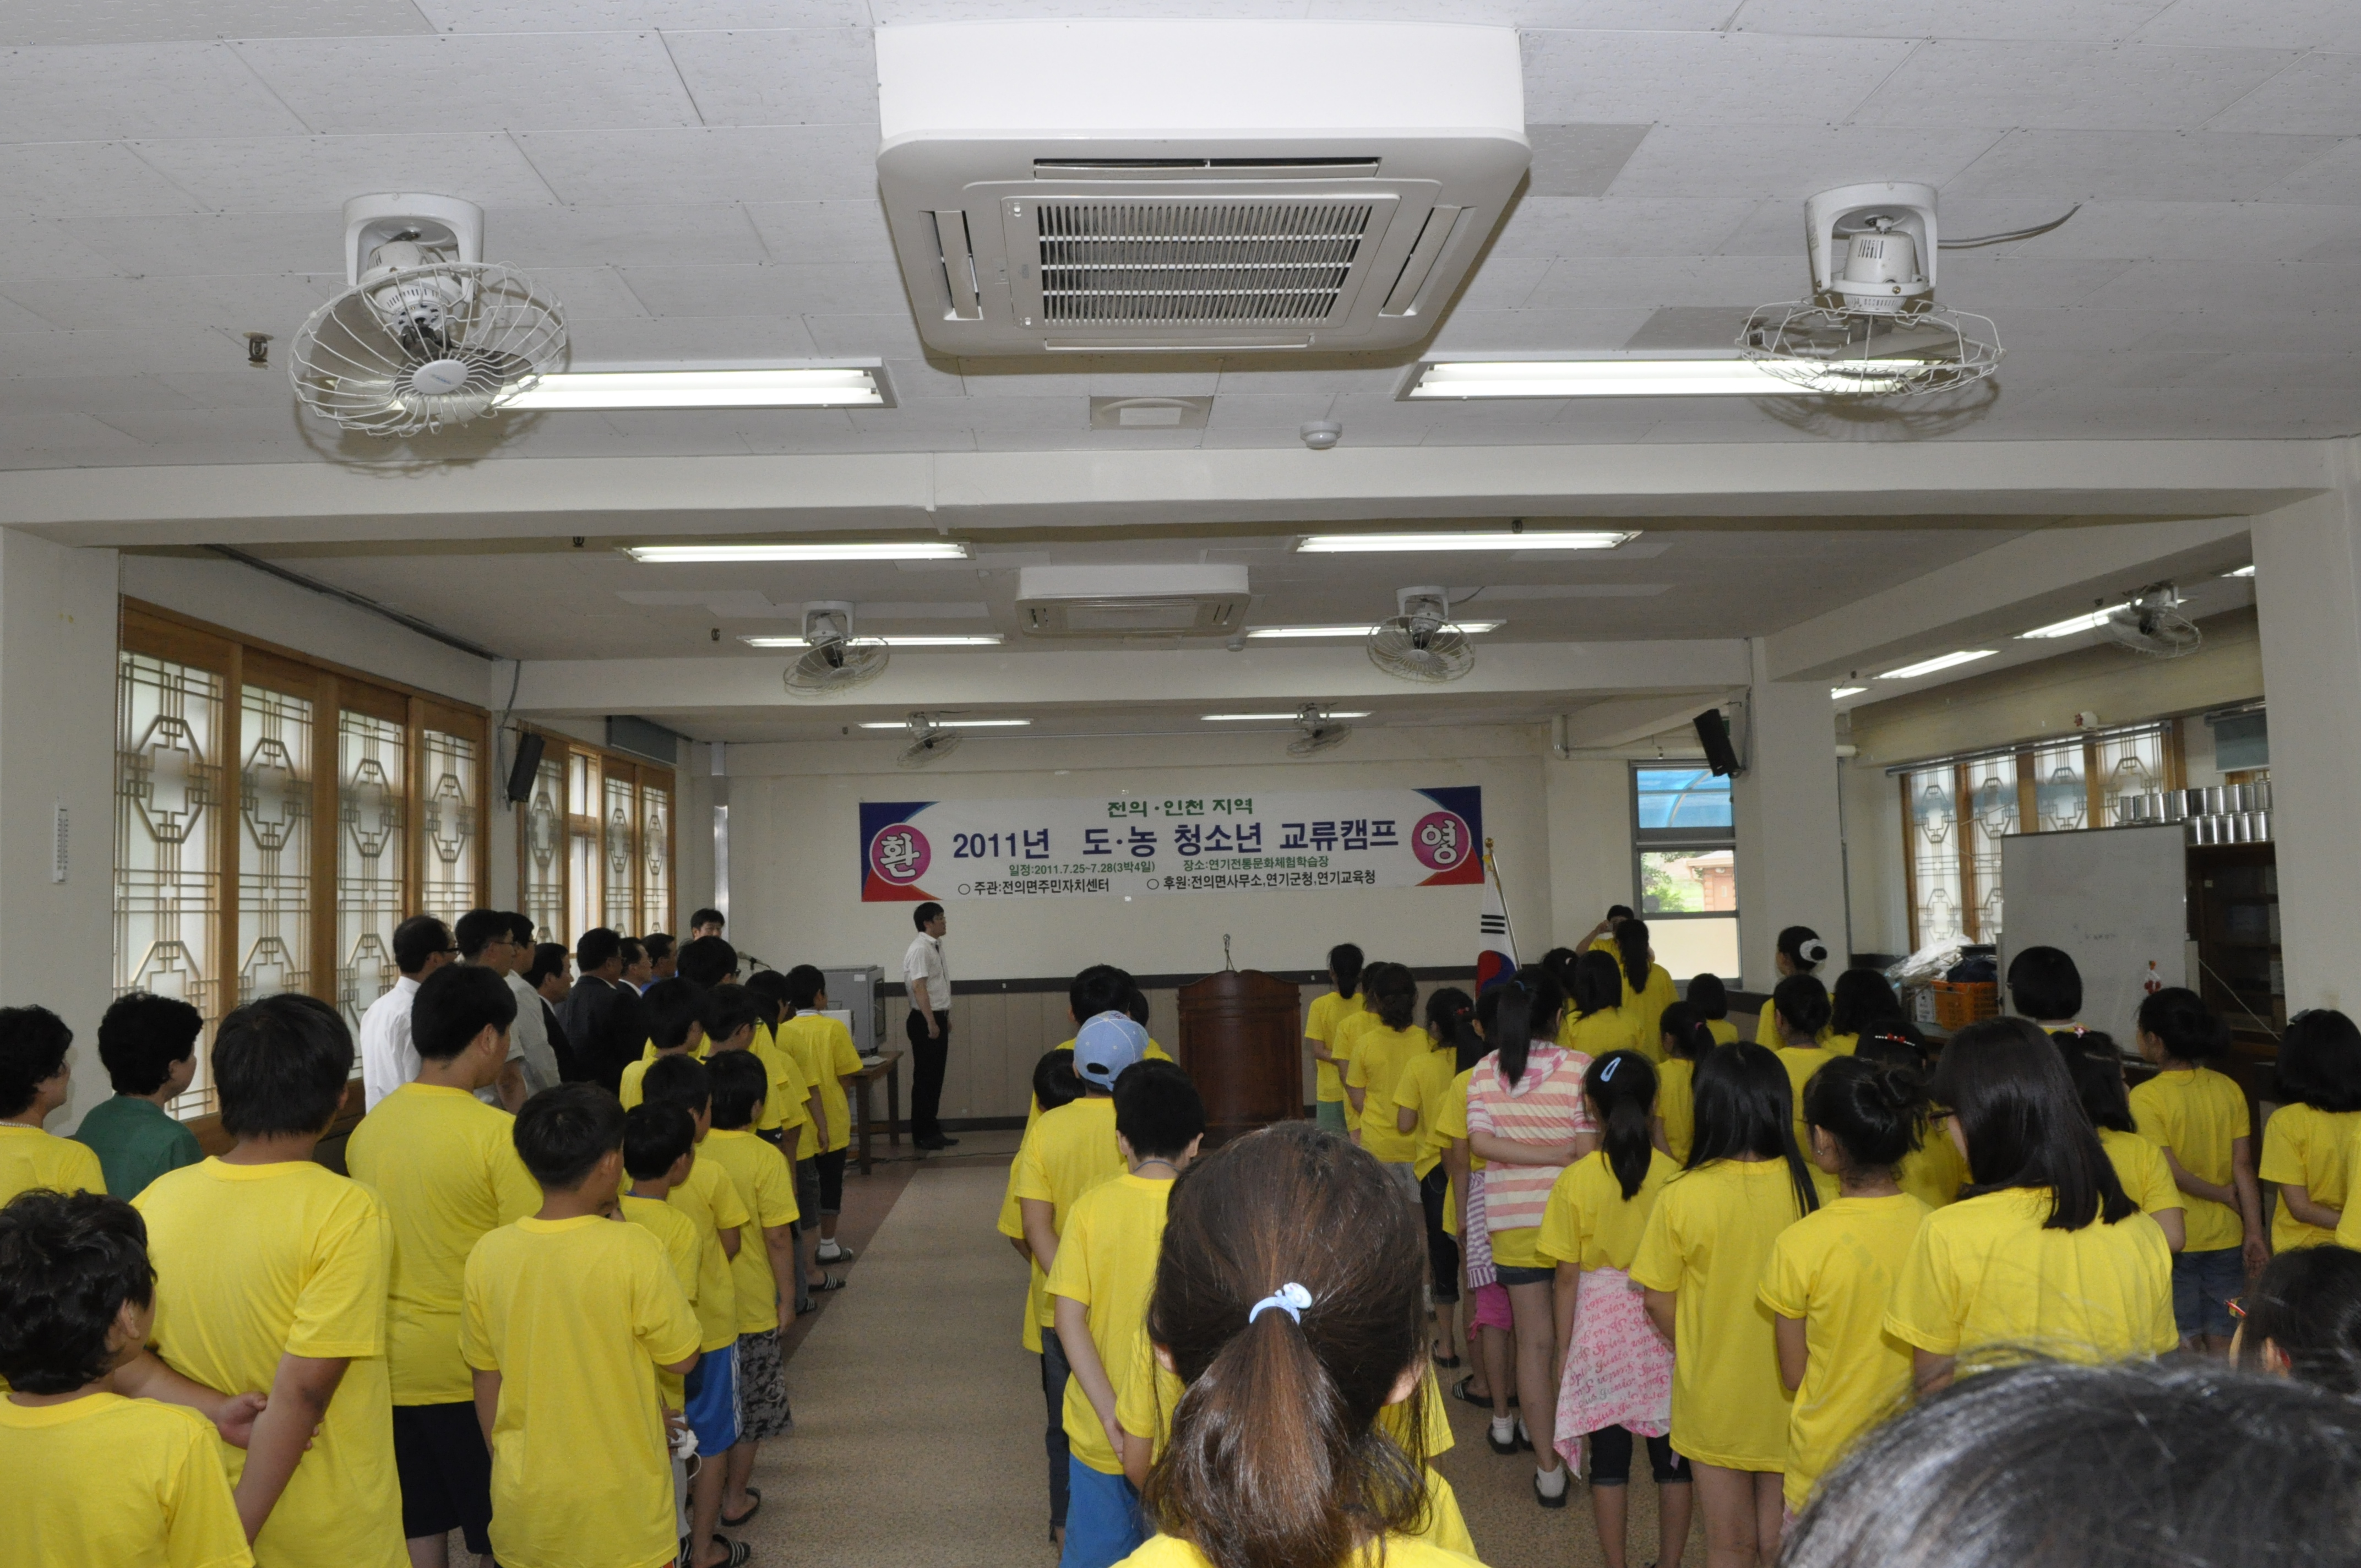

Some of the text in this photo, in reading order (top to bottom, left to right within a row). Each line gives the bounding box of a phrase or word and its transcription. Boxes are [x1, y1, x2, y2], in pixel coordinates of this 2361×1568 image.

[1107, 798, 1253, 818] 전의·인천 지역
[953, 819, 1399, 859] 2011년 도·농 청소년 교류캠프
[1420, 819, 1457, 865] 영
[879, 832, 921, 878] 환
[1183, 855, 1329, 872] 장소:연기전통문화체험학습장
[974, 878, 1109, 896] 주관:전의면주민자치센터
